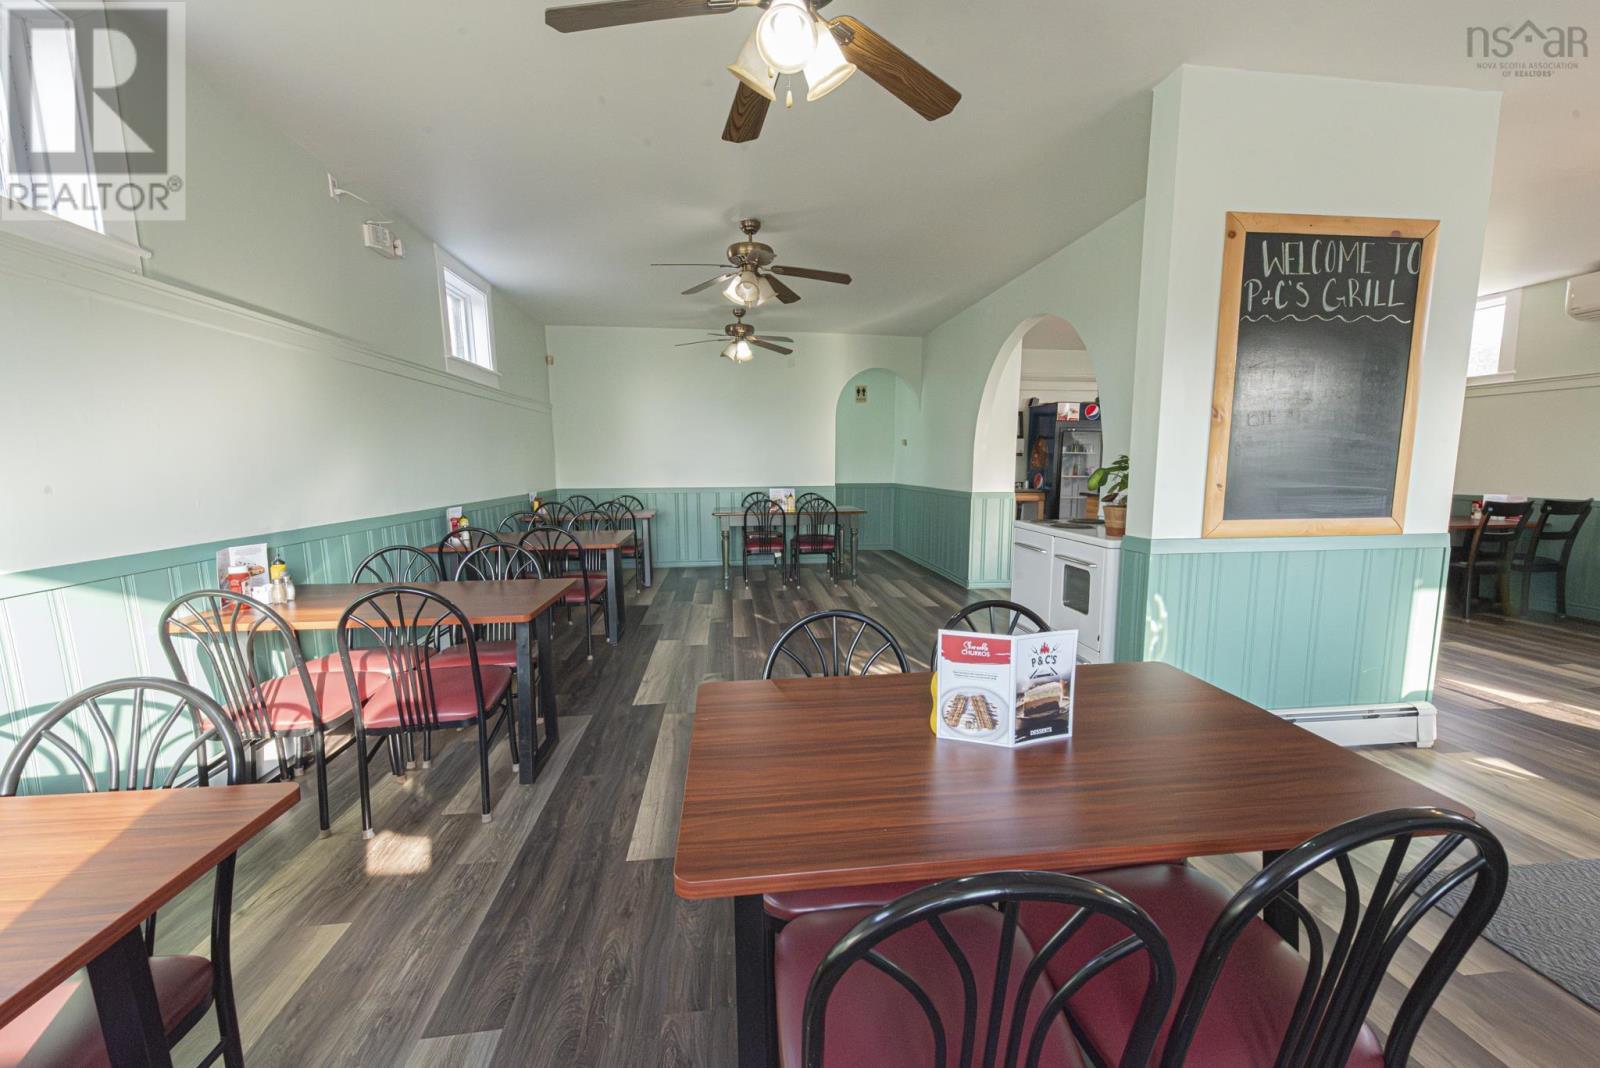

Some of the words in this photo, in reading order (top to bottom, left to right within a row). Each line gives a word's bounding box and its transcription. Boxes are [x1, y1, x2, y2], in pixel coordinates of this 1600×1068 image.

[1262, 239, 1376, 278] WELCOME
[1388, 241, 1422, 275] TO
[1322, 277, 1405, 312] GRILL
